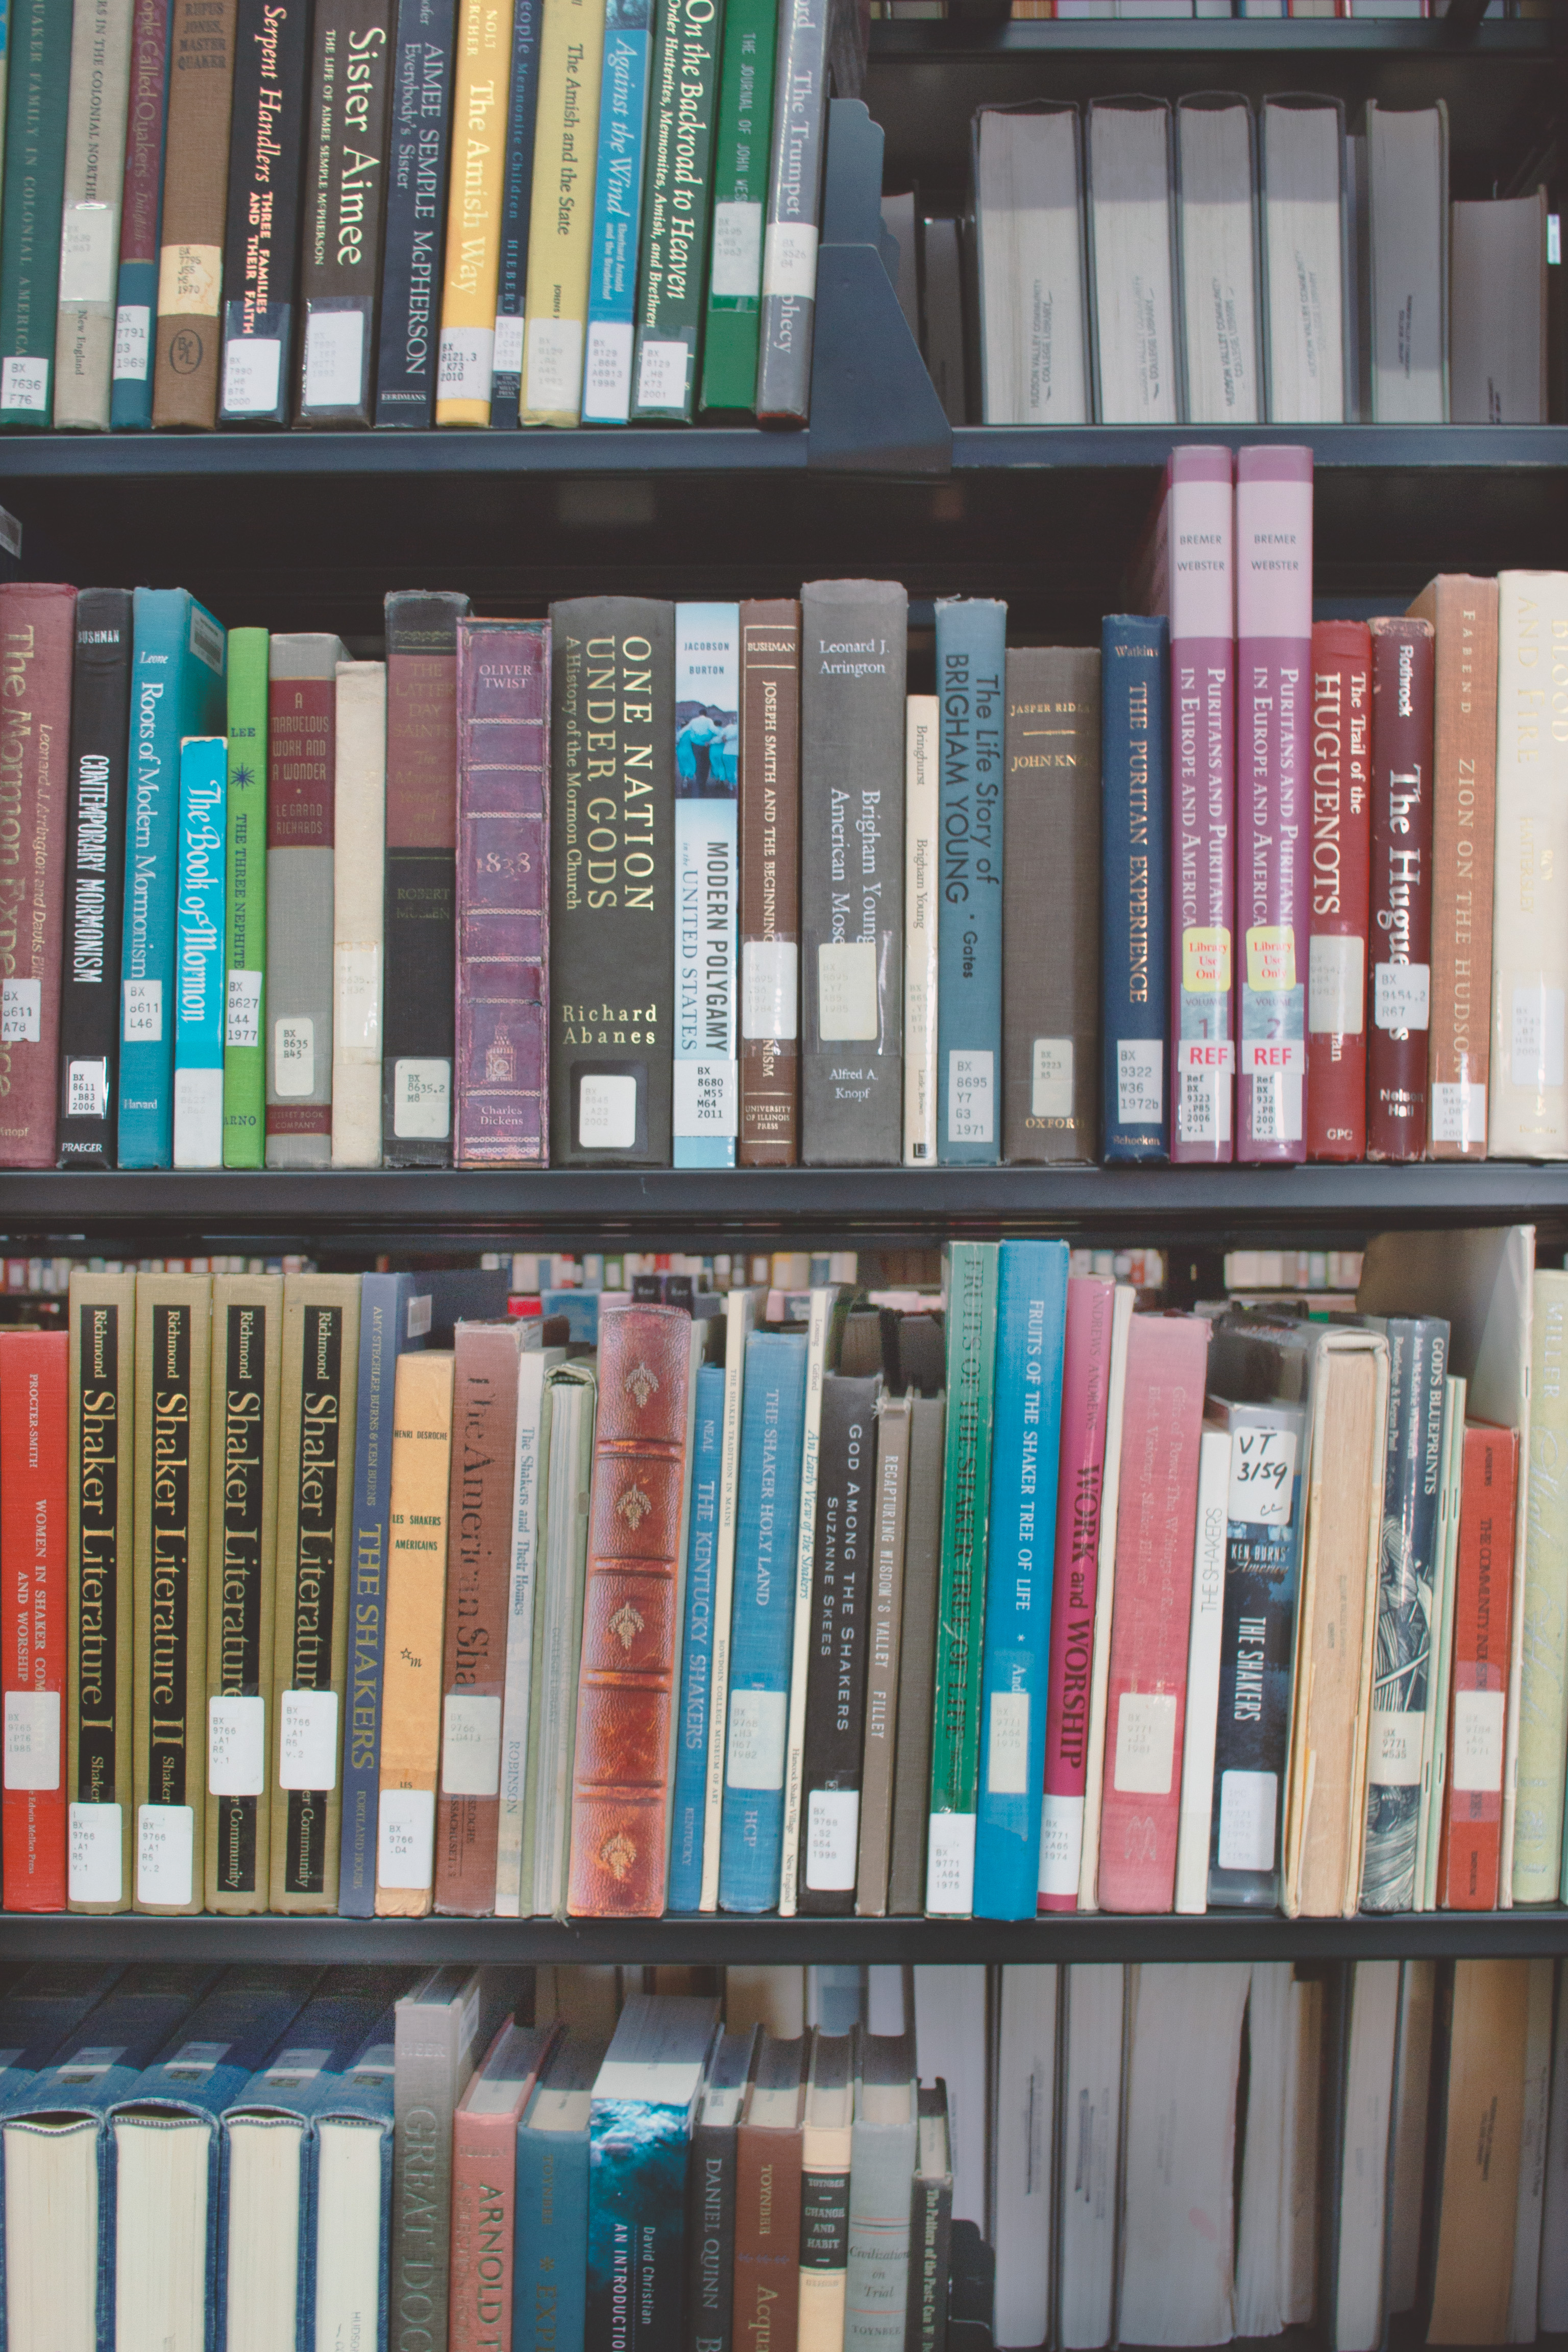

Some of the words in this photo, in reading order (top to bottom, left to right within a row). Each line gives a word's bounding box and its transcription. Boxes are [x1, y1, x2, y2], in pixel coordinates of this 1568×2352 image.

[255, 5, 287, 79] Serpent
[324, 30, 336, 53] THE
[684, 0, 714, 38] On
[324, 57, 334, 81] LIFE
[345, 28, 386, 132] Sister
[421, 42, 444, 118] AIMEE
[568, 44, 583, 73] The
[607, 38, 638, 115] Against
[662, 37, 678, 106] Hutterites,
[681, 43, 710, 76] the
[323, 85, 332, 99] OF
[469, 81, 494, 131] The
[564, 80, 580, 128] Amish
[792, 70, 813, 113] The
[256, 87, 282, 182] Handlers
[321, 106, 331, 141] AIMEE
[562, 133, 577, 162] and
[611, 123, 634, 154] the
[675, 82, 707, 185] Backroad
[319, 145, 329, 189] SEMPLE
[653, 109, 673, 190] Mennonites,
[782, 121, 809, 214] Trumpet
[415, 130, 439, 219] SEMPLE
[464, 139, 490, 228] Amish
[561, 167, 576, 193] the
[606, 157, 632, 217] Wind
[250, 193, 260, 223] AND
[261, 192, 273, 238] THREE
[338, 146, 380, 265] Aimee
[557, 197, 574, 235] State
[650, 193, 667, 239] Amish,
[672, 189, 695, 211] to
[315, 194, 327, 265] McPHERSON
[247, 236, 258, 280] THEIR
[451, 237, 485, 295] Way
[649, 243, 661, 268] and
[667, 216, 694, 300] Heaven
[257, 248, 271, 315] FAMILIES
[406, 231, 433, 374] McPHERSON
[646, 272, 662, 329] Brethren
[243, 289, 254, 333] FAITH
[11, 380, 41, 390] 7636
[1180, 535, 1222, 545] BREMER
[1178, 561, 1224, 571] WEBSTER
[566, 636, 581, 650] A
[684, 642, 729, 651] JACOBSON
[819, 641, 875, 654] Leonard
[479, 665, 532, 675] OLIVER
[484, 678, 528, 689] TWIST
[561, 654, 581, 717] History
[623, 636, 652, 723] ONE
[690, 666, 724, 674] BURTON
[819, 662, 886, 677] Arrington
[1351, 672, 1366, 707] The
[1399, 645, 1414, 717] Rothrock
[140, 682, 164, 739] Roots
[586, 636, 616, 781] UNDER
[945, 654, 969, 785] BRIGHAM
[976, 675, 1000, 719] The
[1130, 682, 1147, 729] THE
[139, 743, 161, 765] of
[567, 721, 581, 741] of
[567, 743, 580, 767] the
[976, 731, 1000, 773] Life
[1351, 715, 1366, 755] Trail
[1130, 741, 1147, 845] PURITAN
[1313, 673, 1341, 915] HUGUENOTS
[1351, 762, 1366, 781] of
[77, 755, 110, 872] CONTEMPORARY
[135, 768, 160, 848] Modern
[188, 779, 221, 824] The
[566, 772, 581, 845] Mormon
[970, 782, 998, 847] Story
[1351, 786, 1365, 814] the
[1390, 764, 1422, 834] The
[624, 744, 654, 911] NATION
[945, 795, 969, 904] YOUNG
[184, 825, 221, 890] Book
[587, 798, 617, 909] GODS
[976, 864, 998, 885] of
[567, 849, 582, 911] Church
[706, 842, 729, 929] MODERN
[74, 879, 105, 982] MORMONISM
[131, 855, 157, 979] Mormonism
[179, 896, 209, 922] of
[682, 870, 698, 958] UNITED
[1129, 856, 1148, 1003] EXPERIENCE
[182, 920, 217, 1021] Mormon
[963, 930, 978, 978] Gates
[563, 1004, 657, 1022] Richard
[681, 969, 698, 1050] STATES
[706, 941, 728, 1052] POLYGAMY
[228, 1031, 257, 1040] 1977
[564, 1027, 655, 1044] Abanes
[1190, 1047, 1228, 1064] REF
[1254, 1048, 1292, 1065] REF
[72, 1102, 94, 1111] 2006
[698, 1079, 723, 1087] 8680
[480, 1116, 523, 1125] Dickens
[481, 1106, 522, 1115] Charles
[698, 1110, 723, 1119] 2011
[1027, 1300, 1044, 1356] FRUITS
[1026, 1360, 1041, 1384] OF
[29, 1374, 38, 1468] PROCTER-SMITH
[1024, 1391, 1040, 1425] THE
[83, 1390, 116, 1515] Shaker
[155, 1393, 188, 1515] Shaker
[394, 1430, 413, 1439] HENRI
[417, 1430, 448, 1441] DESROCHE
[849, 1425, 862, 1470] GOD
[1021, 1430, 1038, 1495] SHAKER
[35, 1499, 46, 1558] WOMEN
[393, 1515, 404, 1524] LES
[410, 1514, 440, 1525] SHAKERS
[844, 1481, 860, 1559] AMONG
[1019, 1502, 1035, 1541] TREE
[1072, 1464, 1099, 1563] WORK
[358, 1523, 381, 1595] THE
[824, 1497, 839, 1585] SUZANNE
[1018, 1545, 1032, 1579] OF
[18, 1572, 29, 1604] AND
[35, 1566, 46, 1582] IN
[842, 1572, 855, 1615] THE
[1016, 1579, 1031, 1611] LIFE
[1069, 1572, 1085, 1608] and
[35, 1589, 46, 1651] SHAKER
[81, 1526, 115, 1704] Literature
[154, 1526, 187, 1705] Literature
[821, 1595, 835, 1656] SKEES
[1238, 1616, 1266, 1645] THE
[17, 1612, 29, 1682] WORSHIP
[351, 1604, 380, 1769] SHAKERS
[838, 1627, 854, 1730] SHAKERS
[1060, 1619, 1090, 1769] WORSHIP
[1233, 1651, 1265, 1722] SHAKERS
[153, 1718, 184, 1748] II
[704, 2159, 722, 2234] DANIEL
[477, 2184, 505, 2323] ARNOLD
[643, 2227, 655, 2261] David
[849, 2246, 909, 2260] Civilization
[642, 2267, 654, 2324] Christian
[700, 2239, 720, 2308] QUINN
[864, 2286, 894, 2298] Trial
